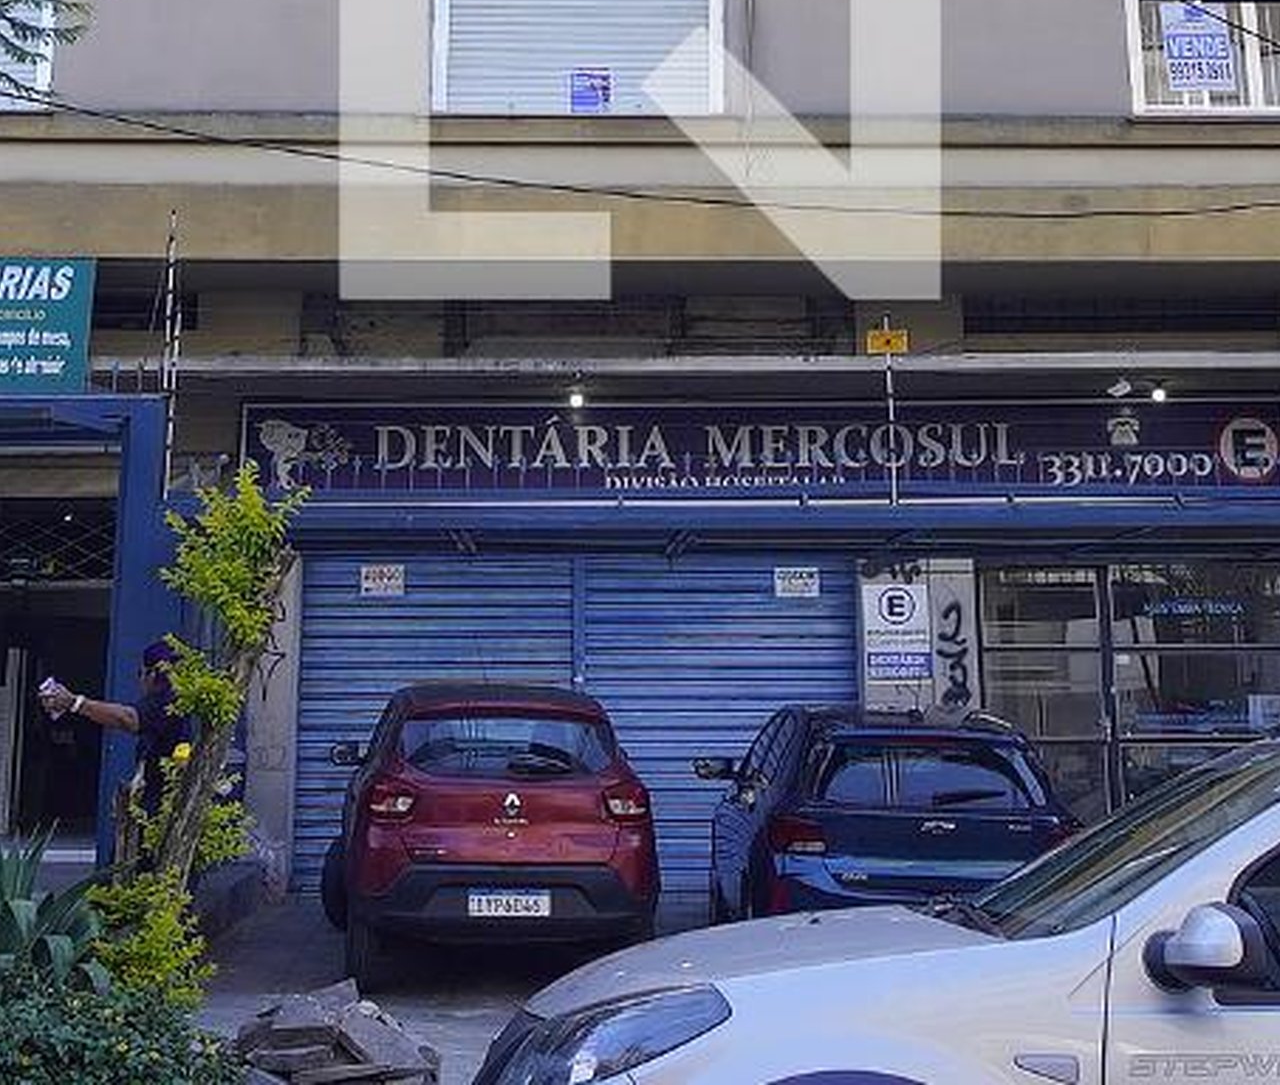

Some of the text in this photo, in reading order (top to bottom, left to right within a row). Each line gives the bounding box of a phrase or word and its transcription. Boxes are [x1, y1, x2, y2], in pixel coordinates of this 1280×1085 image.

[703, 421, 1025, 468] MERCOSUL
[1231, 428, 1269, 467] E
[1041, 452, 1213, 486] 3311.7000
[886, 595, 907, 617] E
